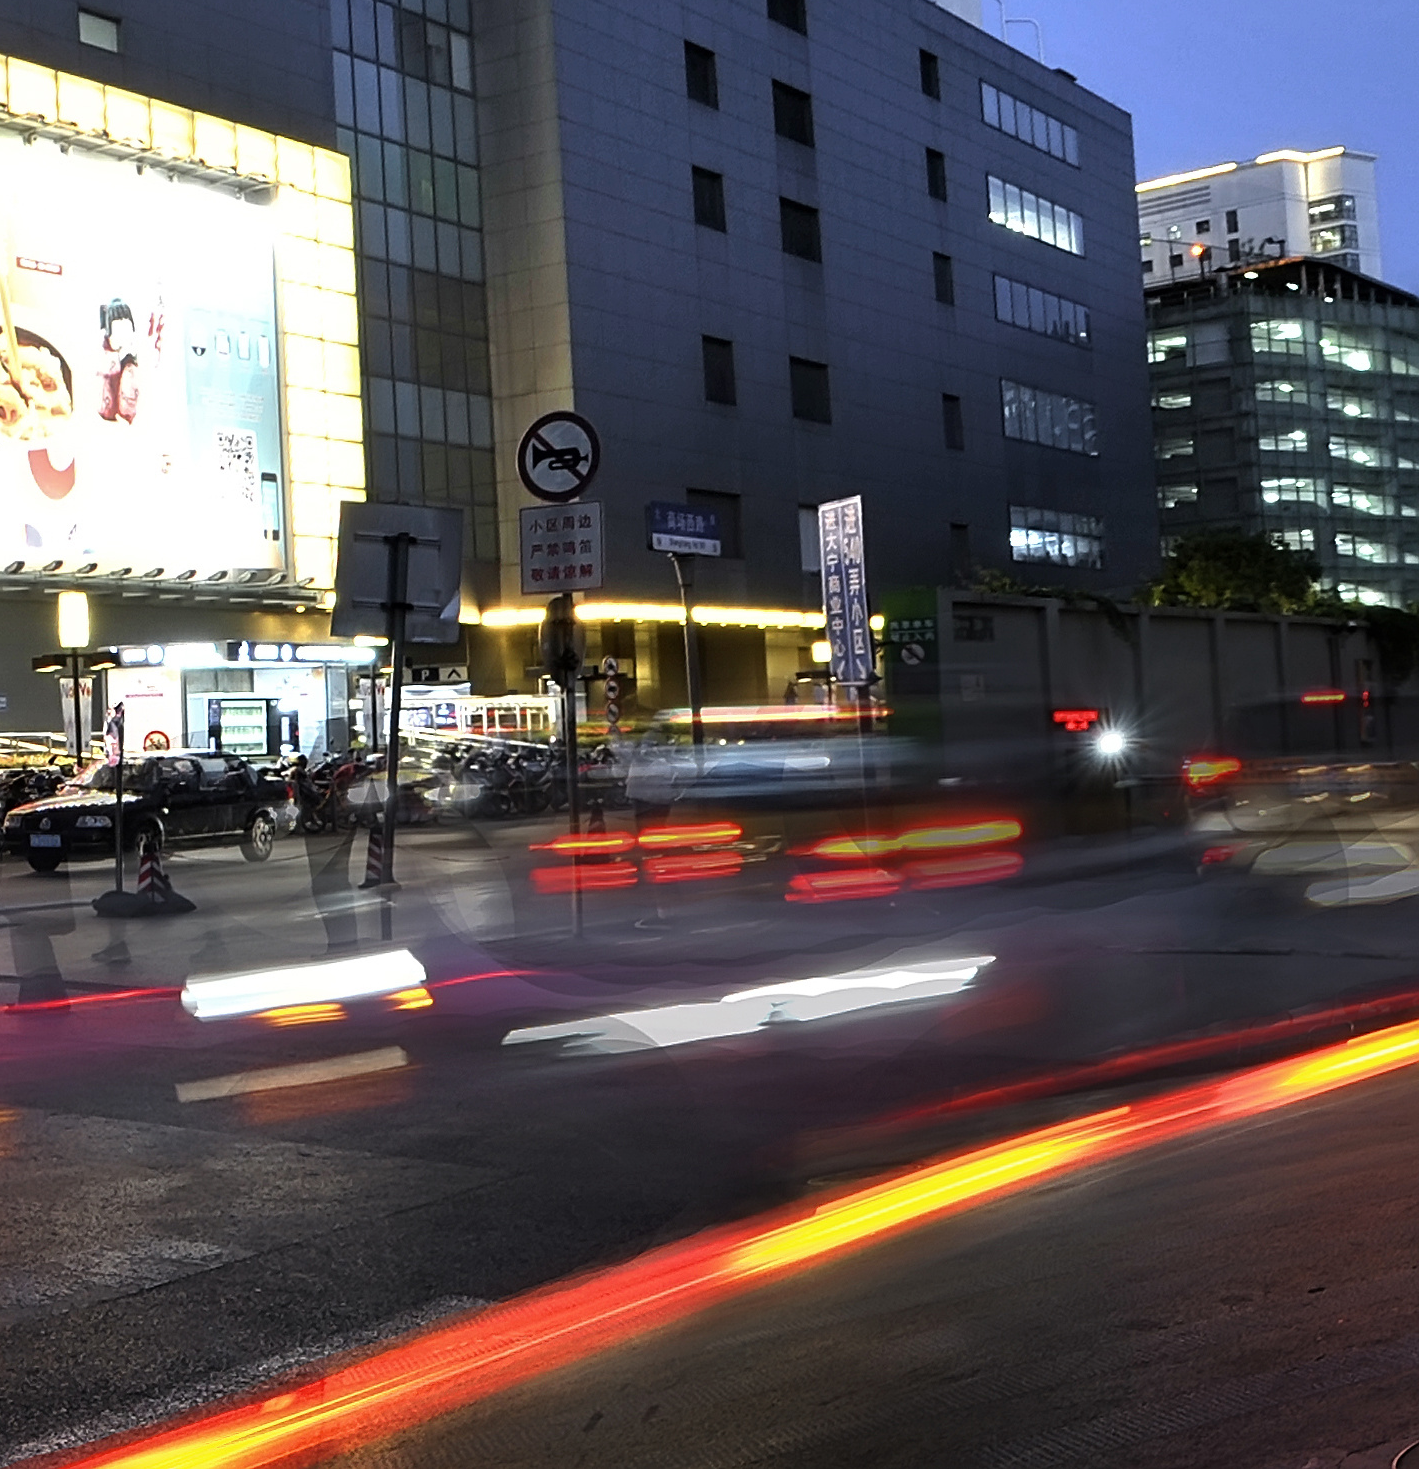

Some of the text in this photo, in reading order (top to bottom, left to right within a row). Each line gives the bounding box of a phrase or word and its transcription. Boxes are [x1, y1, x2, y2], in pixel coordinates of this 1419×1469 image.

[530, 514, 592, 534] 小区周边
[824, 510, 846, 658] 进大宁商业中心
[421, 669, 430, 681] P
